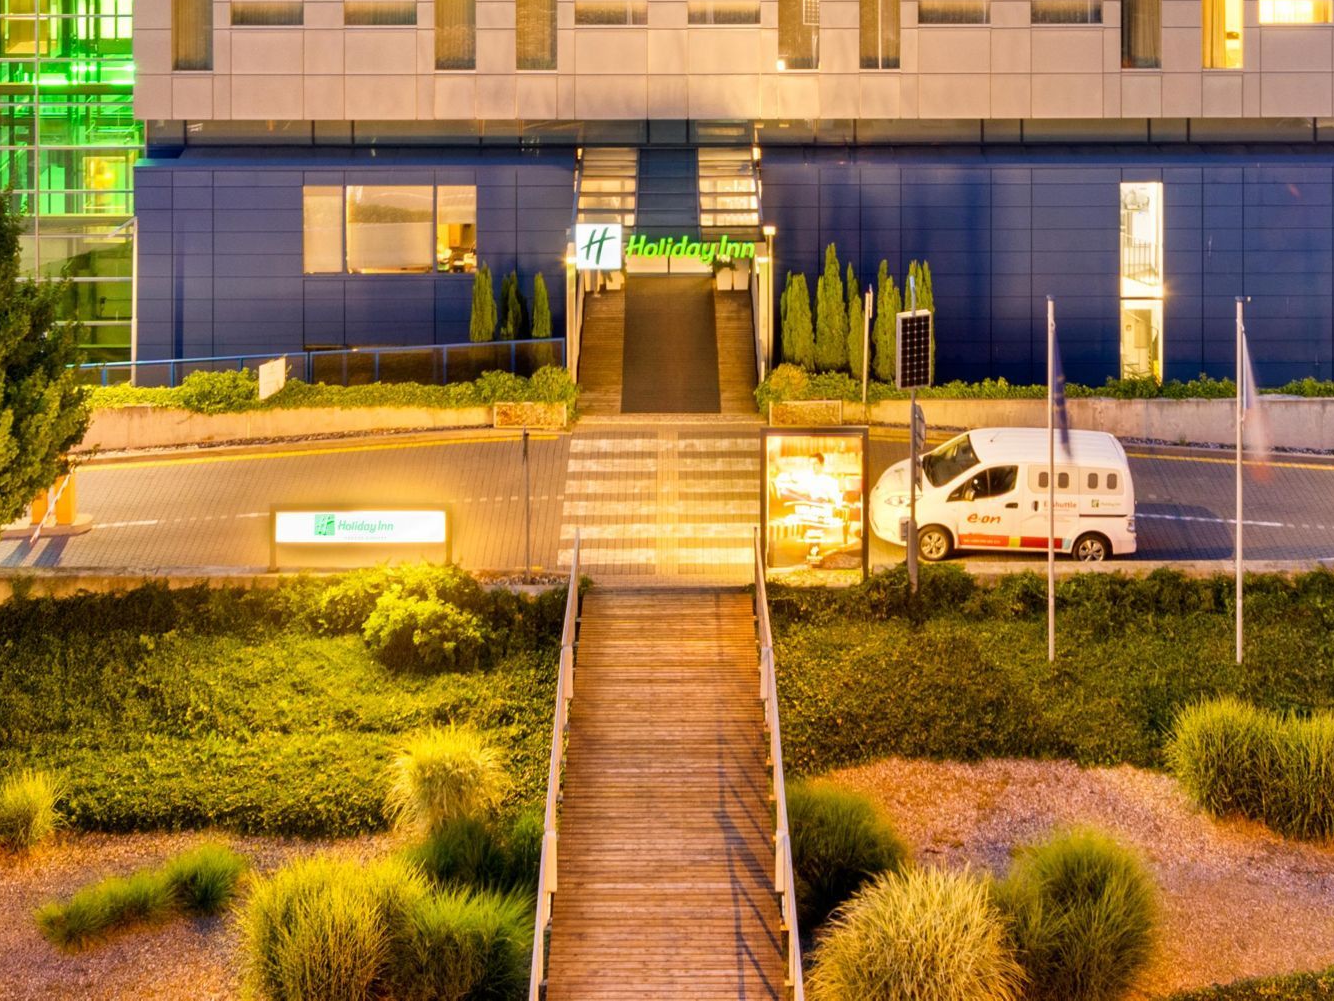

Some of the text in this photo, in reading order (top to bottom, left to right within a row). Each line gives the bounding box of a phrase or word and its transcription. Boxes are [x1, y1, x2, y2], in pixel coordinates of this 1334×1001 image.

[626, 234, 717, 263] Holiday
[718, 234, 755, 259] Inn
[338, 519, 377, 533] Holiday
[378, 519, 394, 531] Inn
